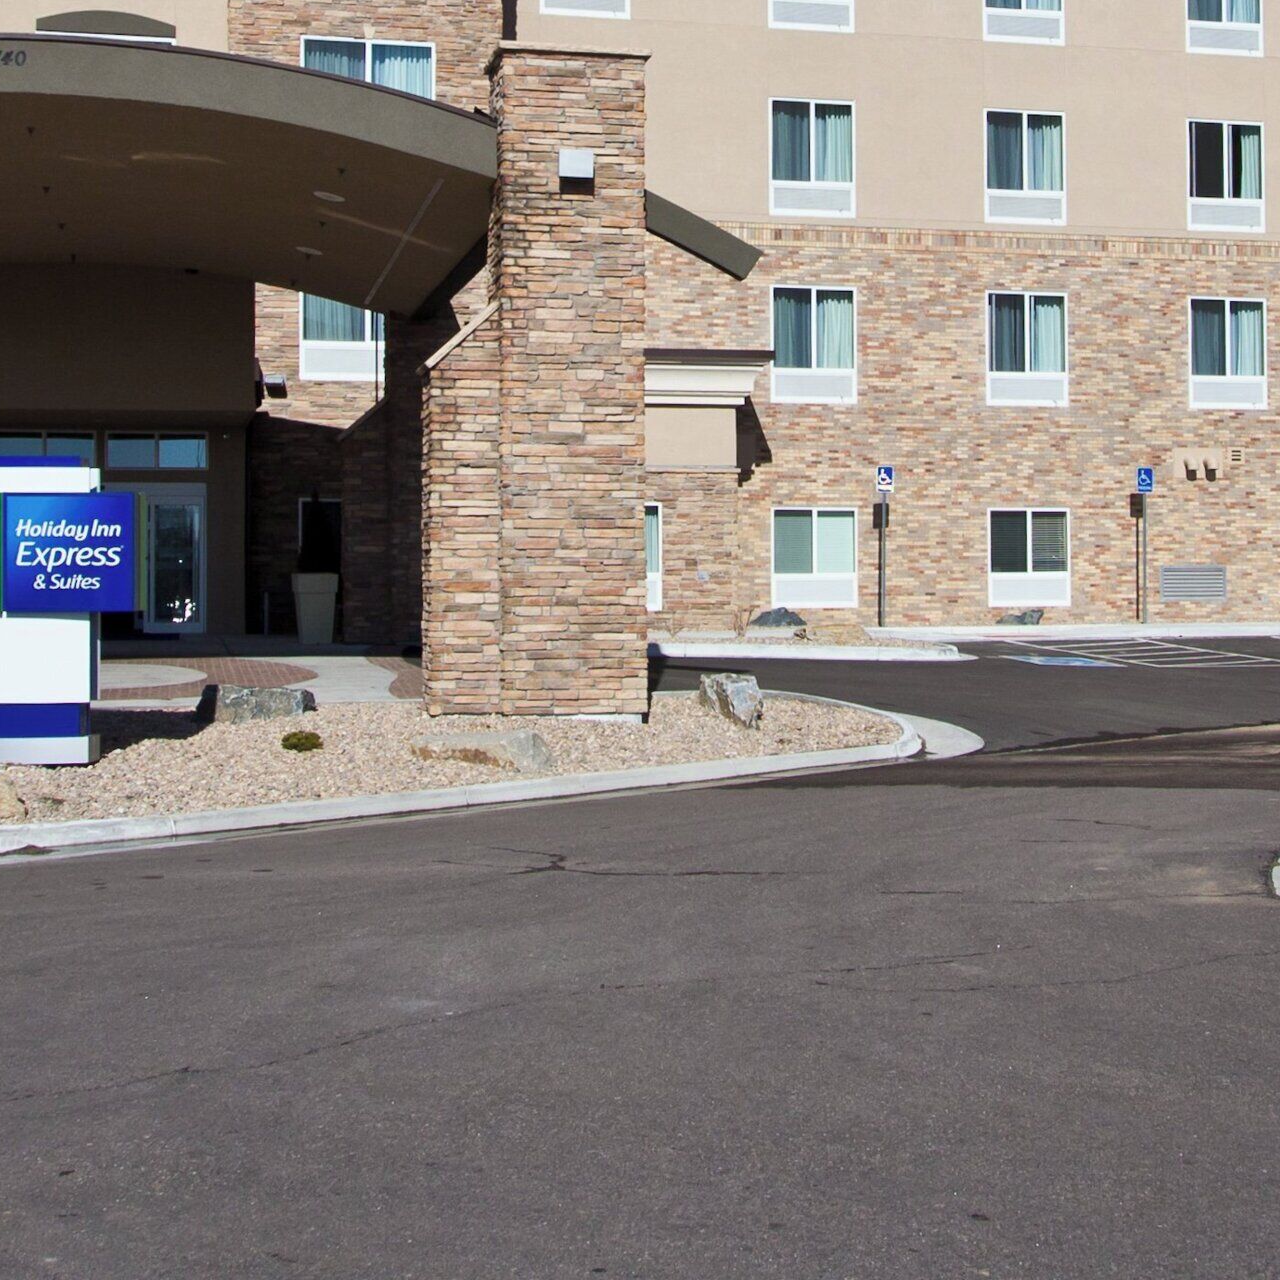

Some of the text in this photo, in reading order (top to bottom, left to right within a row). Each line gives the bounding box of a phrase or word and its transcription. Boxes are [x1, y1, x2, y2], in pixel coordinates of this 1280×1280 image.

[15, 519, 121, 541] Holiday Inn
[16, 541, 122, 573] Express
[33, 573, 101, 589] & Suites
